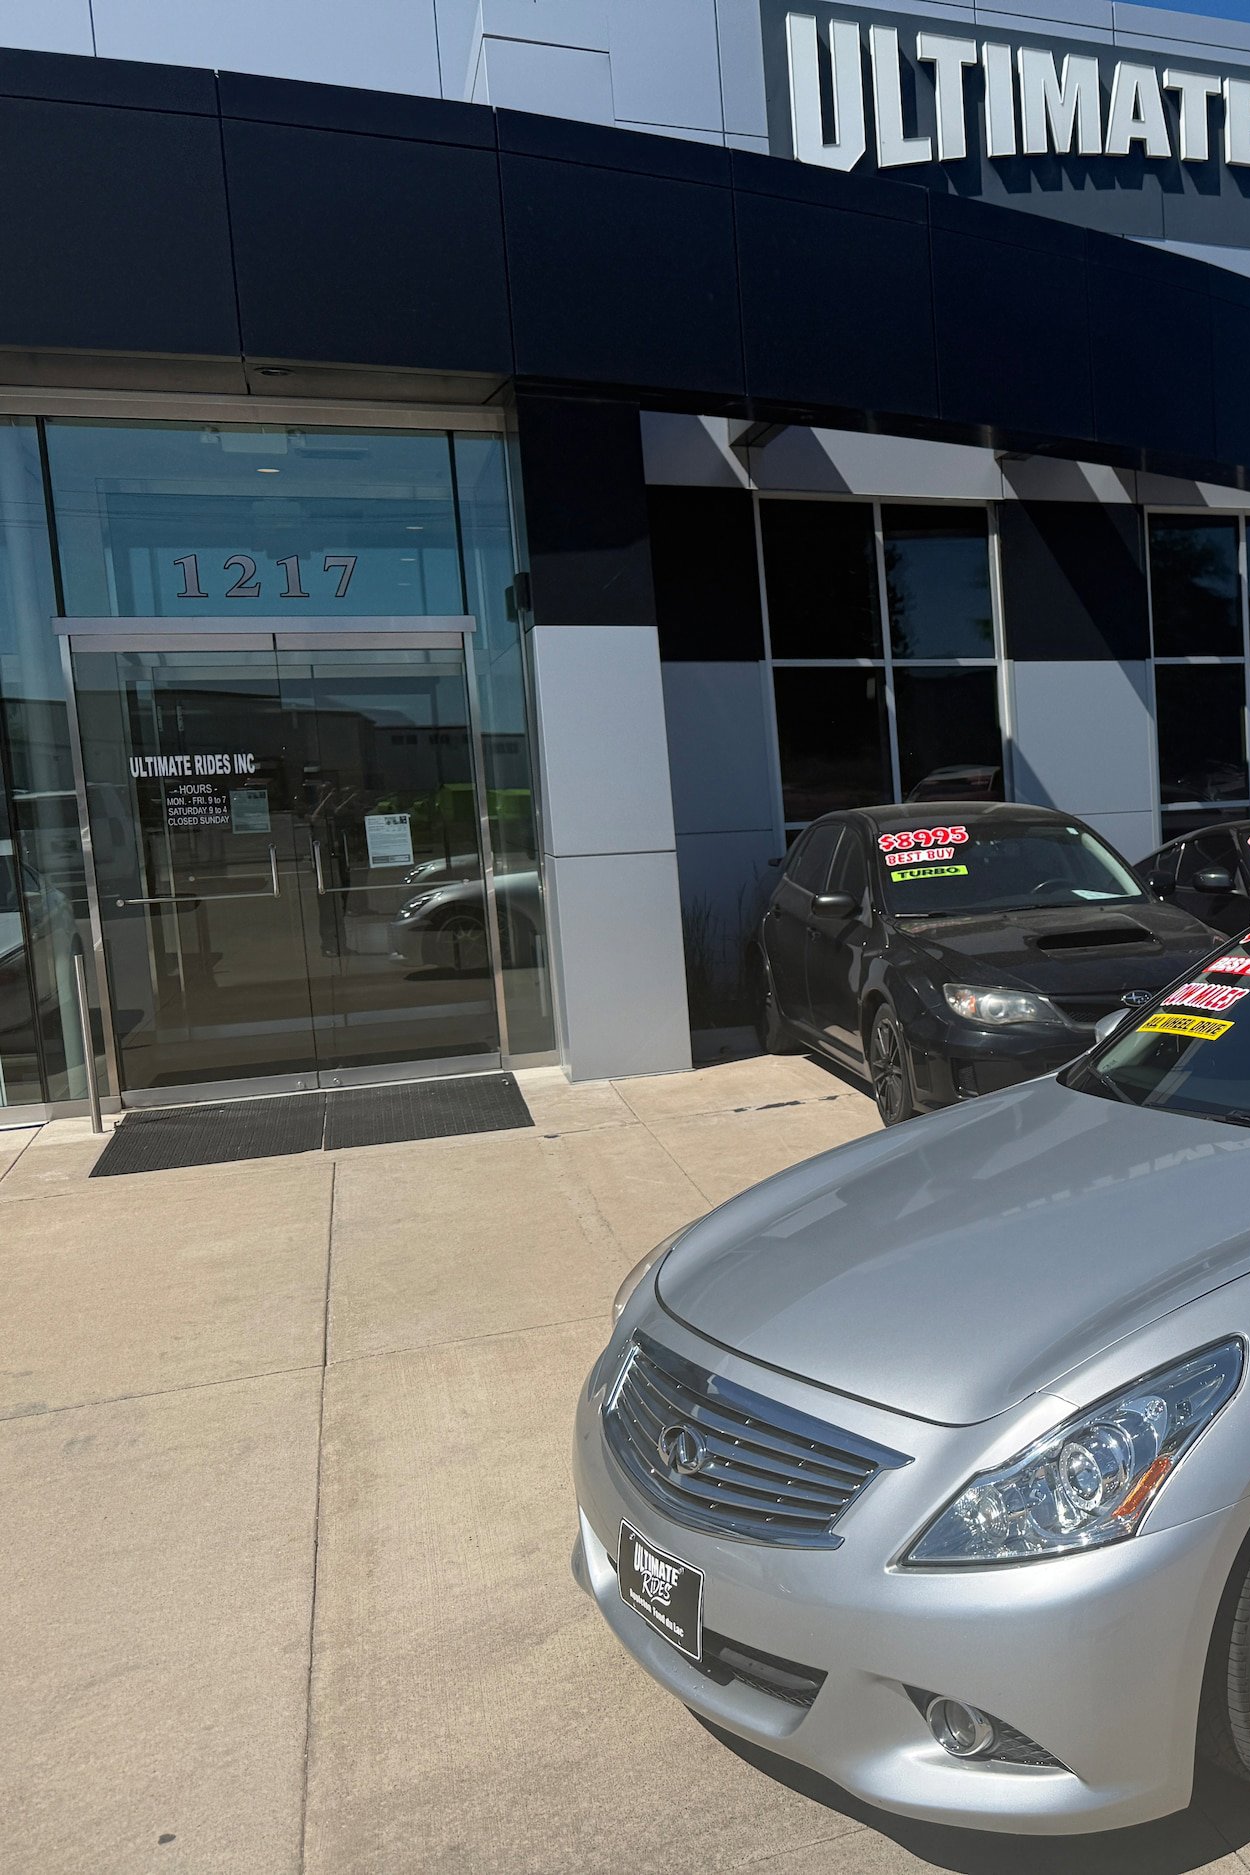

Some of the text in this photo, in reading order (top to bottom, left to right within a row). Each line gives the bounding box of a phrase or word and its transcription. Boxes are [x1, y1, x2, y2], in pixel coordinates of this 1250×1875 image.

[173, 553, 358, 598] 1217
[130, 753, 256, 778] ULTIMATE RIDES INC
[179, 784, 213, 795] HOURS
[167, 797, 187, 806] MON.
[192, 796, 207, 805] FRI.
[208, 796, 213, 804] 9
[214, 796, 221, 804] to
[222, 795, 227, 804] 7
[168, 805, 228, 816] SATURDAY 9 to 4
[168, 816, 230, 826] CLOSED SUNDAY
[878, 826, 969, 852] $8995
[885, 847, 955, 866] BEST BUY
[898, 867, 959, 878] TURBO
[1189, 984, 1250, 1012] MILES
[1165, 1016, 1198, 1031] WHEEL
[1187, 1020, 1228, 1036] DRIVE
[634, 1541, 679, 1587] ULTIMATE
[641, 1570, 673, 1603] RIDES
[673, 1622, 684, 1637] Lac
